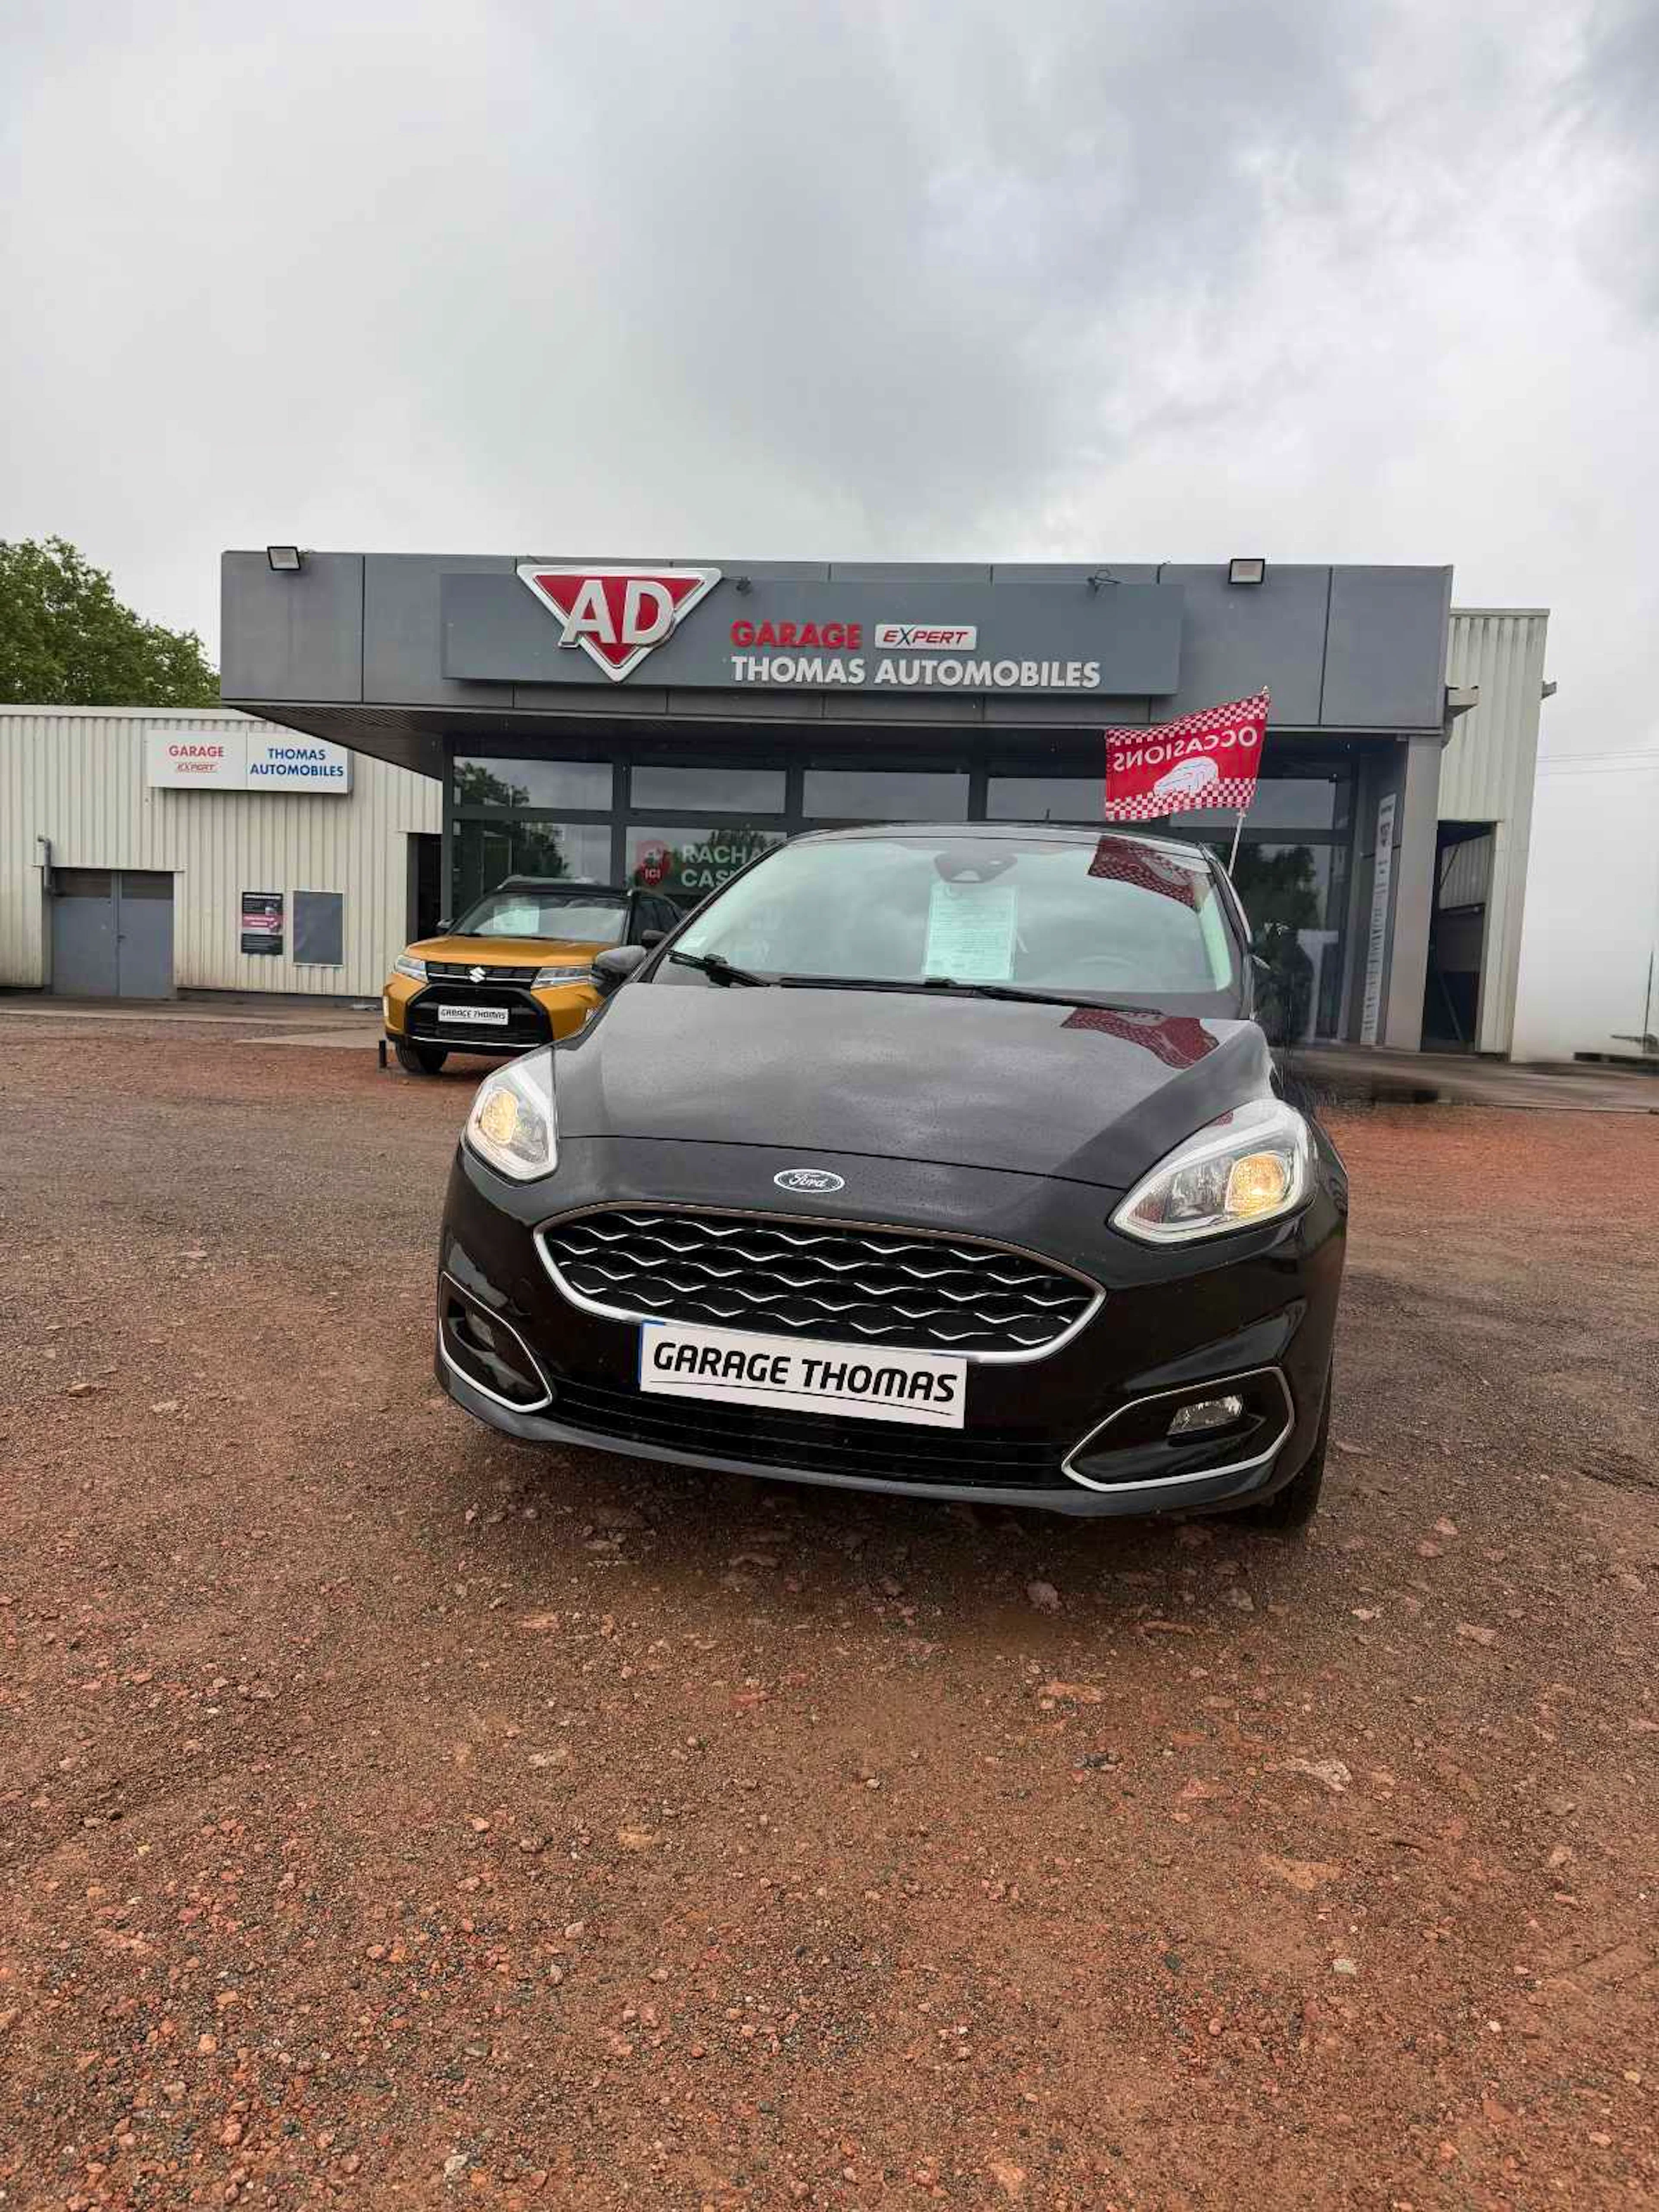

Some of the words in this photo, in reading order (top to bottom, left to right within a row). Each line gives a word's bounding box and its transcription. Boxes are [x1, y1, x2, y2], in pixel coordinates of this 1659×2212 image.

[562, 579, 675, 645] AD
[730, 619, 863, 649] GARAGE
[883, 626, 969, 646] EXPERT
[731, 656, 865, 684] THOMAS
[873, 659, 1101, 688] AUTOMOBILES
[169, 745, 224, 757] GARAGE
[267, 747, 326, 760] THOMAS
[250, 764, 344, 777] AUTOMOBILES
[789, 1173, 829, 1187] Ford
[653, 1342, 791, 1384] GARAGE
[802, 1359, 958, 1402] THOMAS
